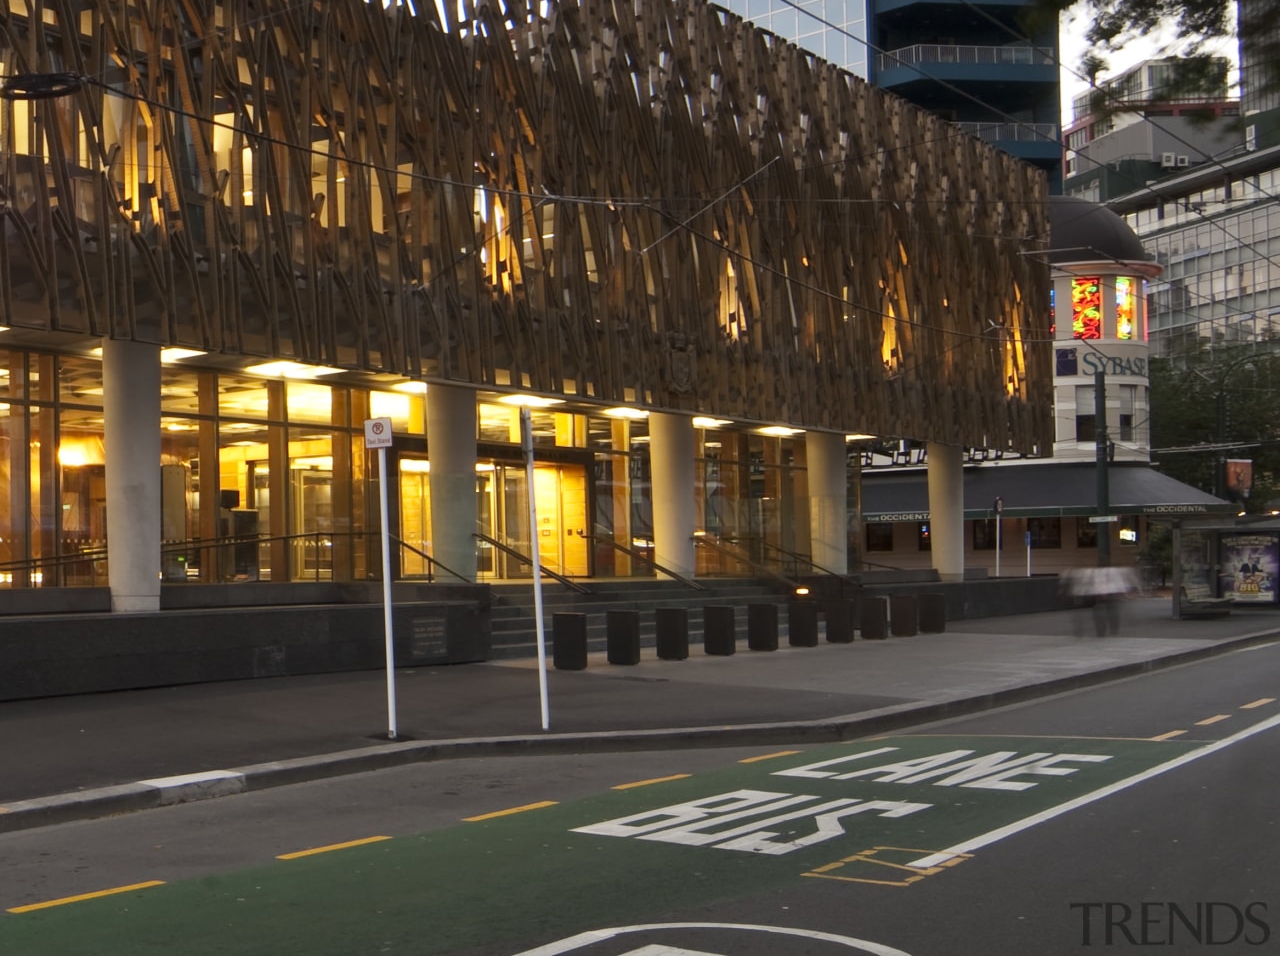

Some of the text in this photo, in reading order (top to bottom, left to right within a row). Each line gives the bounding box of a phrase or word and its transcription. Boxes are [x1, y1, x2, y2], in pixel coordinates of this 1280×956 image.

[1082, 352, 1146, 377] SYBASE
[1156, 505, 1207, 513] OCCIDENTAL
[770, 746, 1114, 791] LANE
[568, 789, 934, 855] BUS
